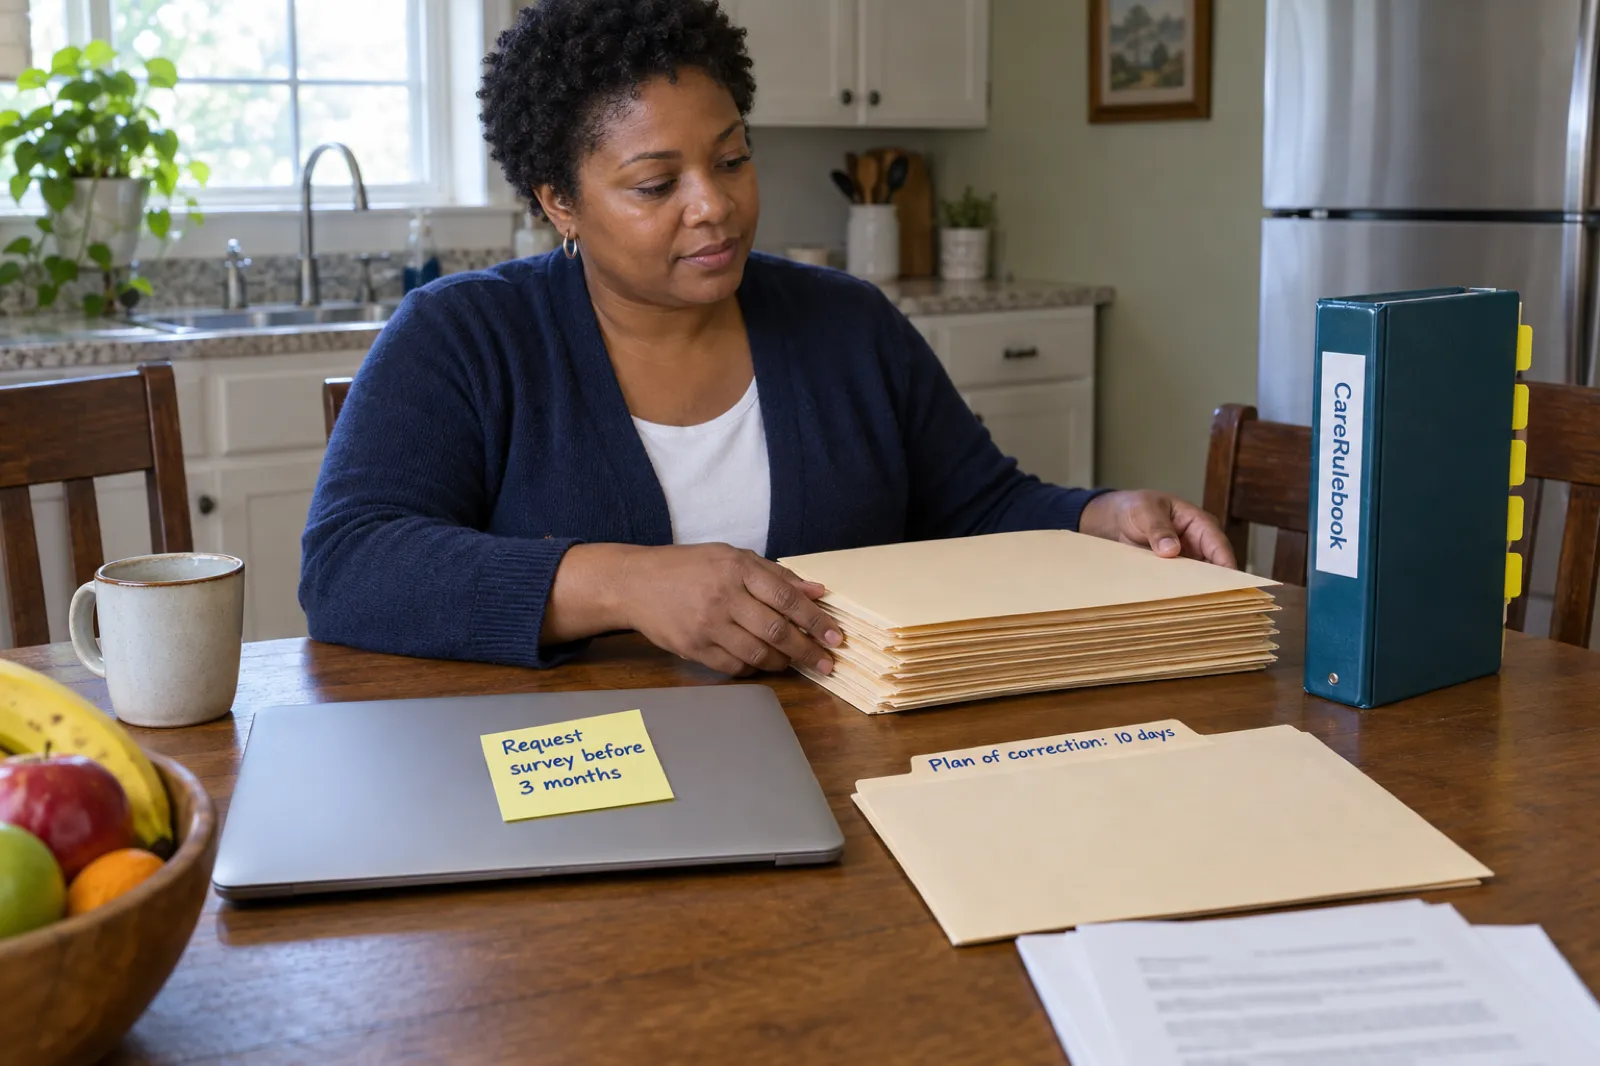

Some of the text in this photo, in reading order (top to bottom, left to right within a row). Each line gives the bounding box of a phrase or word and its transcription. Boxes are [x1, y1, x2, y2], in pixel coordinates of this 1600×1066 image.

[1329, 382, 1352, 551] CareRulebook
[502, 729, 583, 755] Request
[928, 727, 1176, 772] Plan of correction: 10 days
[510, 743, 646, 776] survey before
[518, 767, 622, 796] 3 months
